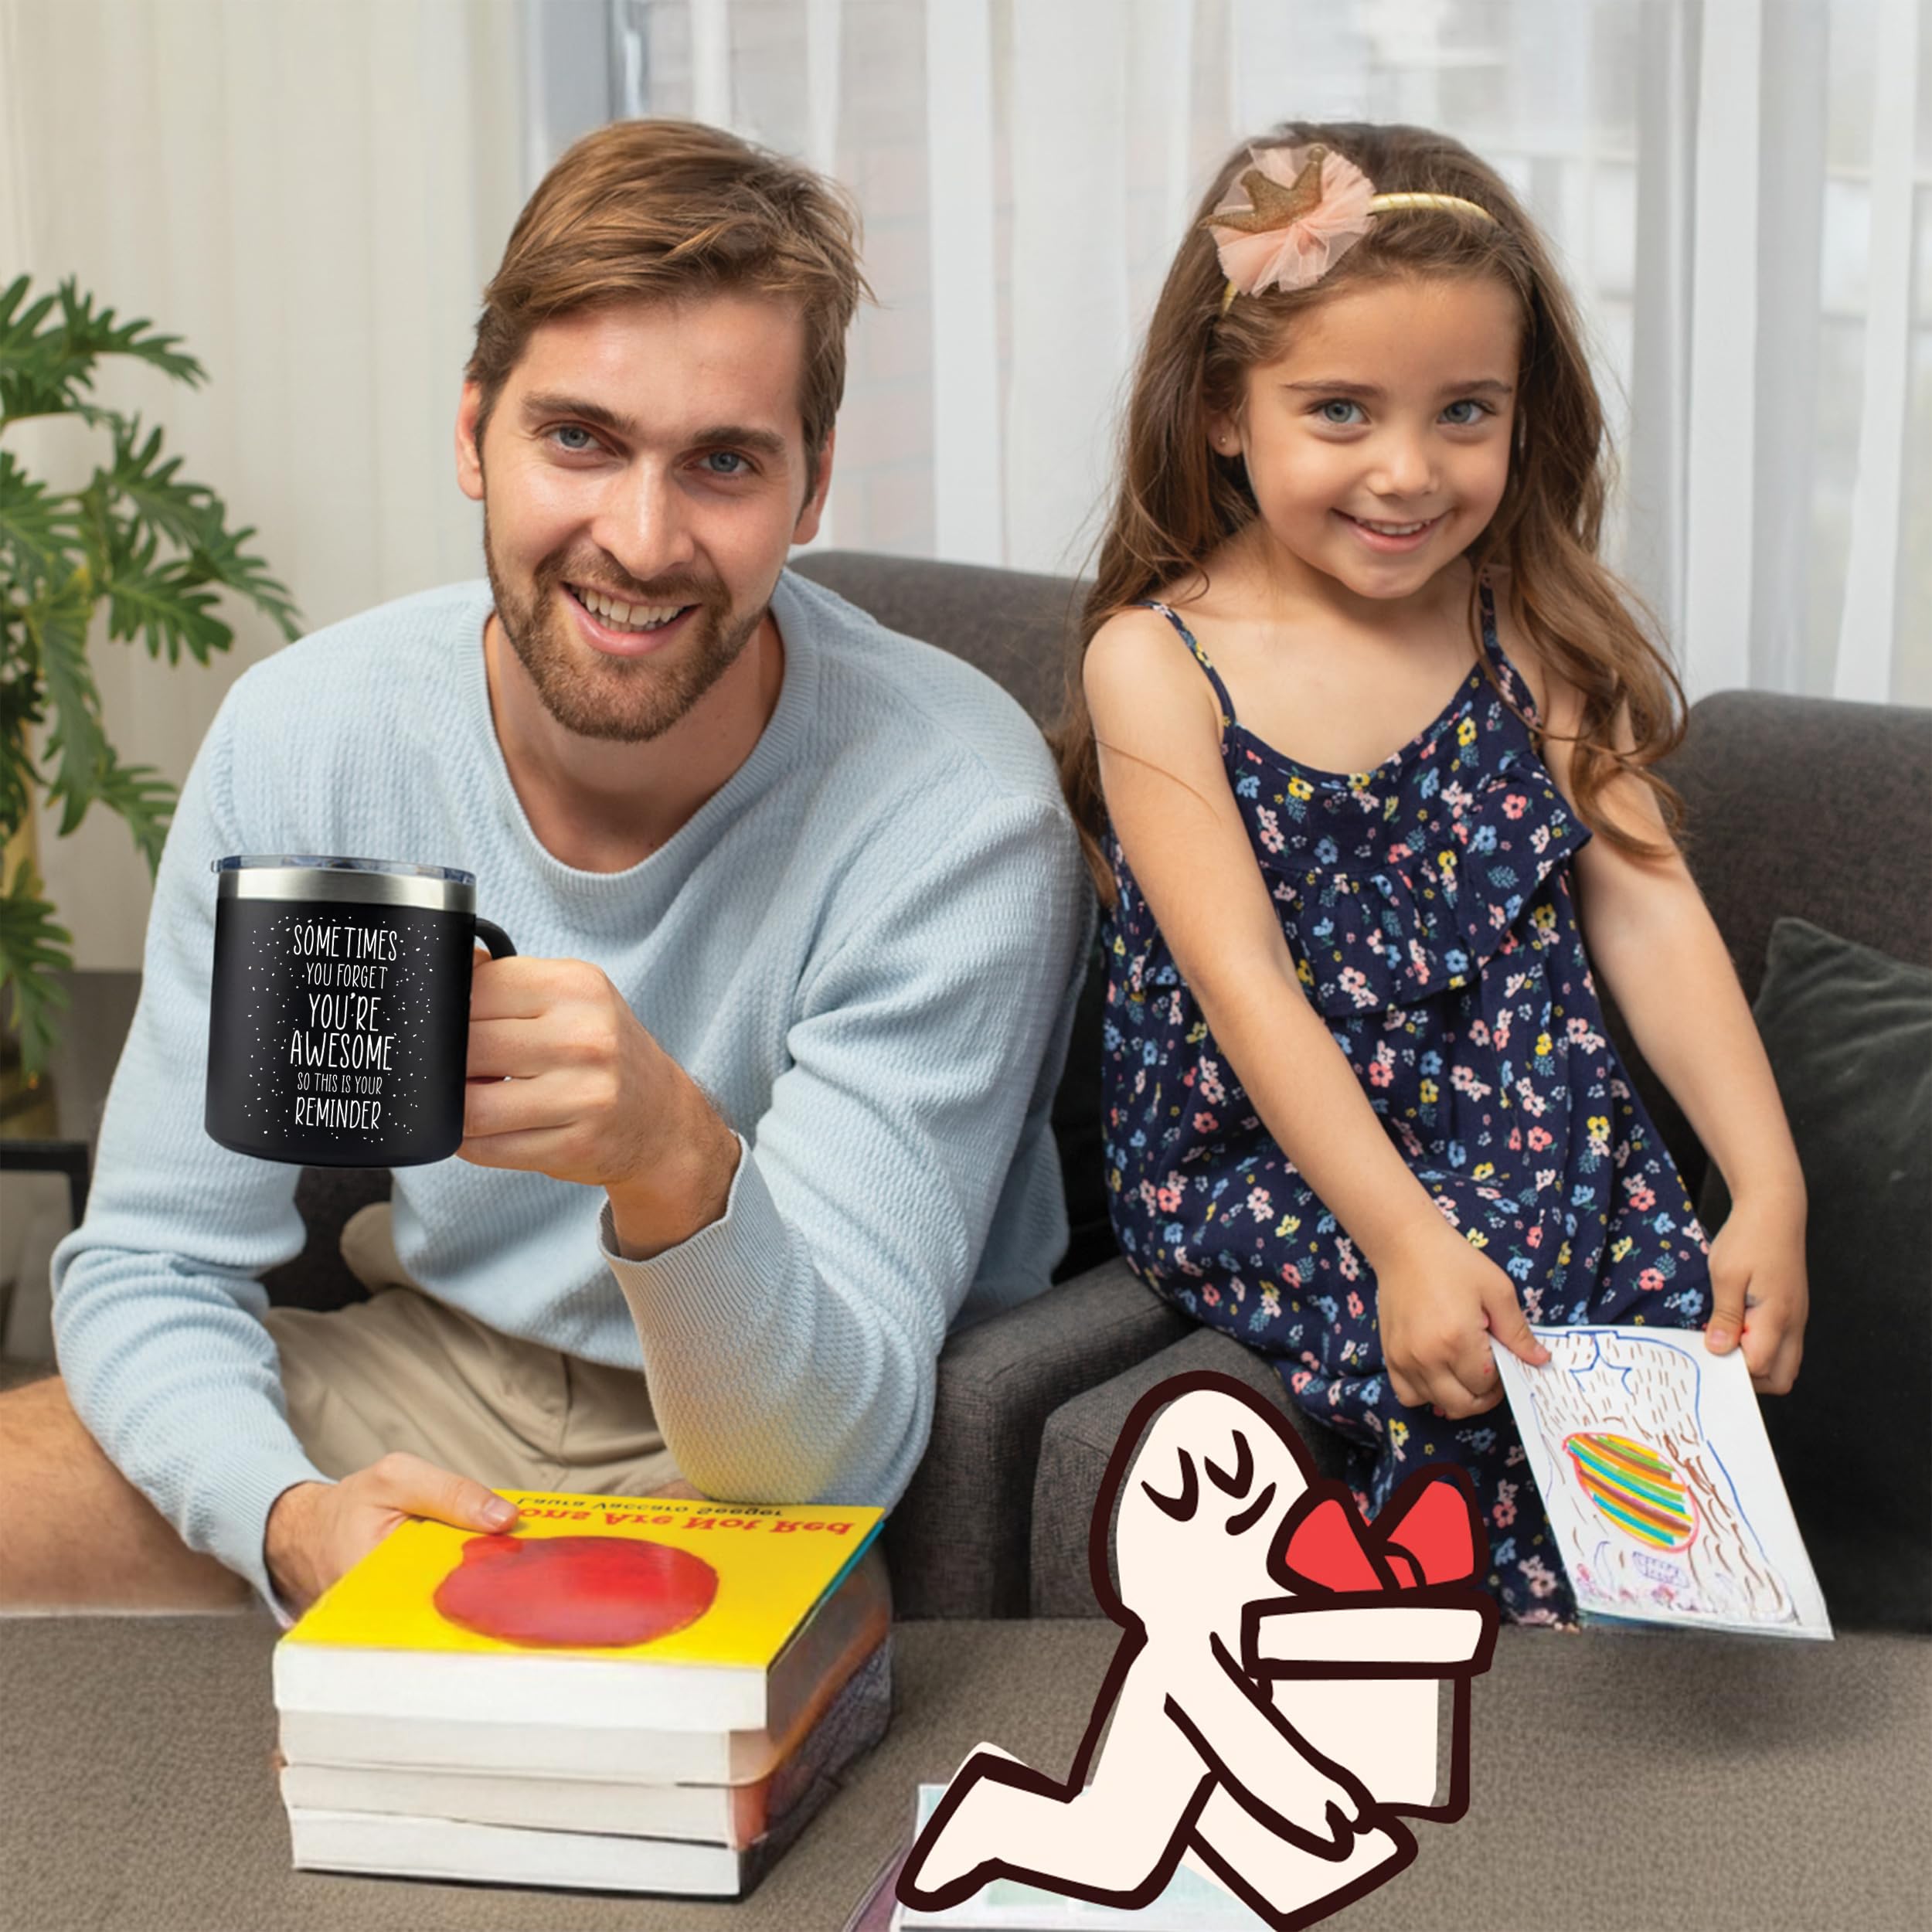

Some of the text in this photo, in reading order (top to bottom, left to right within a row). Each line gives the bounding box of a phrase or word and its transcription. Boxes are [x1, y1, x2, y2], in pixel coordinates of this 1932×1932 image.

[293, 924, 398, 961] SOMETIMES
[306, 962, 388, 990] YOU FORGET
[308, 992, 383, 1032] YOU'RE
[290, 1029, 395, 1071] AWESOME
[297, 1071, 383, 1095] SO THIS IS YOUR
[294, 1096, 381, 1130] REMINDER
